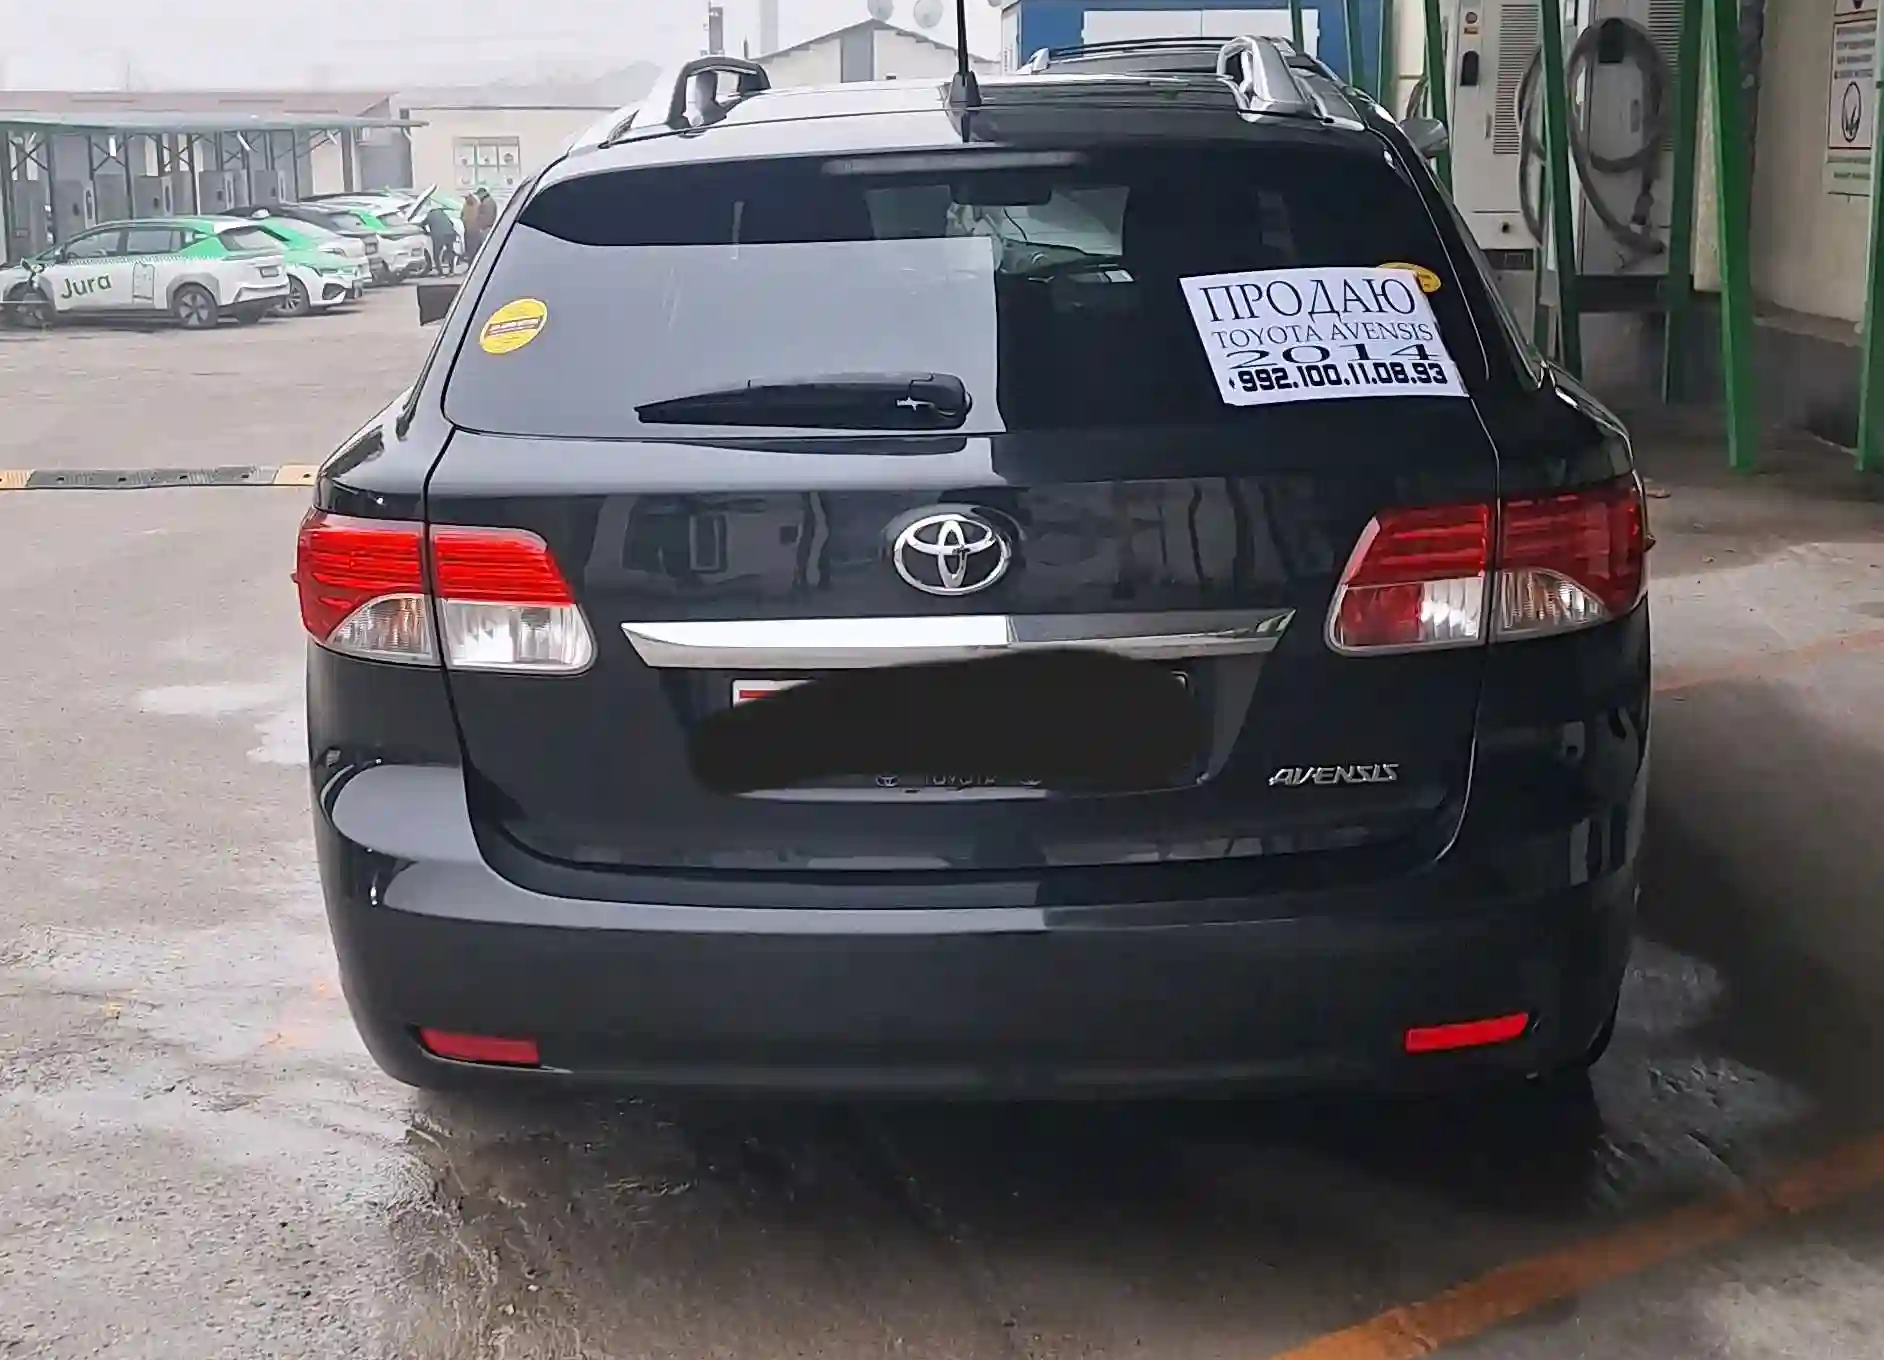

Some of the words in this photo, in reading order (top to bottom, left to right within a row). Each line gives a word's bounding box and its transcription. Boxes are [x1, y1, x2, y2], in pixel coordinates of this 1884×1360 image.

[61, 274, 112, 299] Jura
[1199, 278, 1416, 324] ПРОДАЮ
[1211, 324, 1323, 349] TOYOTA
[1331, 322, 1434, 341] AVENSIS
[1226, 343, 1440, 370] 2014
[1269, 763, 1399, 786] AVENSIS
